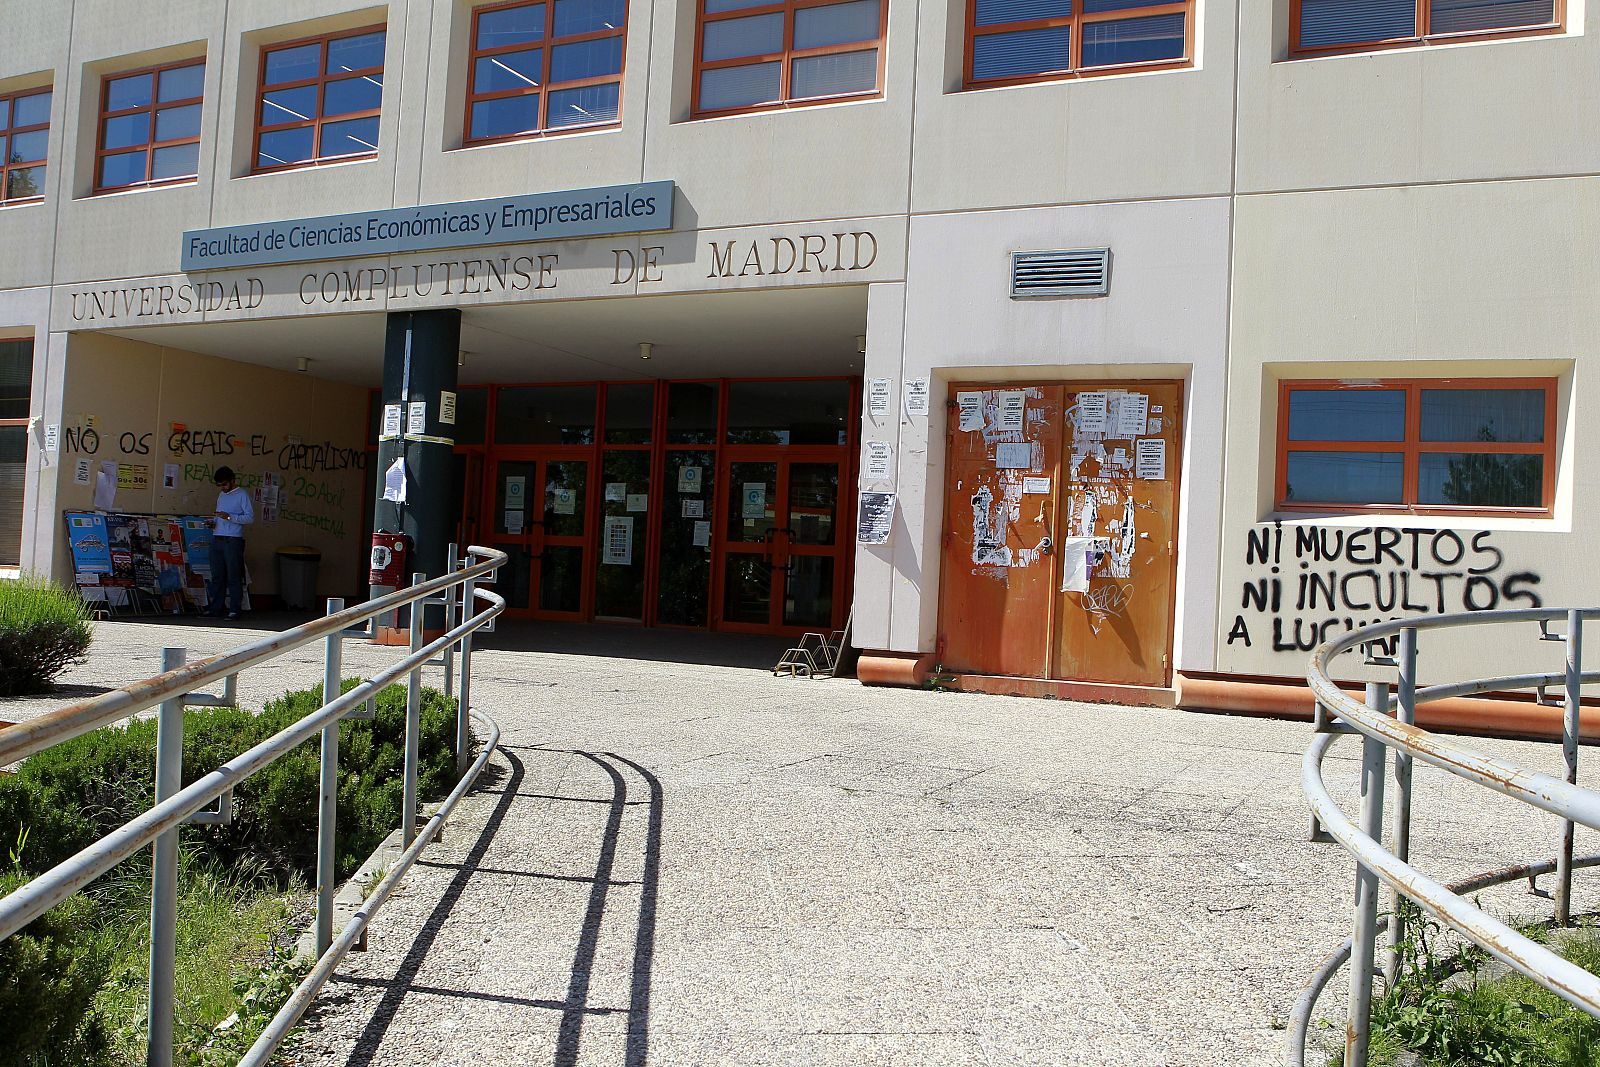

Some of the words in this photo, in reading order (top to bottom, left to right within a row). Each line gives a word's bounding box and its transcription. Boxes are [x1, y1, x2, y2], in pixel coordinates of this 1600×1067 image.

[190, 232, 261, 259] Facultad
[264, 230, 285, 252] de
[289, 222, 363, 249] Ciencias
[366, 211, 480, 242] Económicas
[484, 215, 496, 236] y
[502, 190, 657, 232] Empresariales
[71, 278, 265, 321] UNIVERSIDAD
[300, 254, 560, 306] COMPLUTENSE
[612, 246, 666, 286] DE
[708, 231, 878, 279] MADRID
[66, 427, 99, 454] NO
[120, 432, 153, 455] OS
[251, 435, 274, 456] EL
[278, 441, 369, 472] CAPITALISMO
[1296, 525, 1505, 574] MUERTOS
[1227, 615, 1252, 648] A
